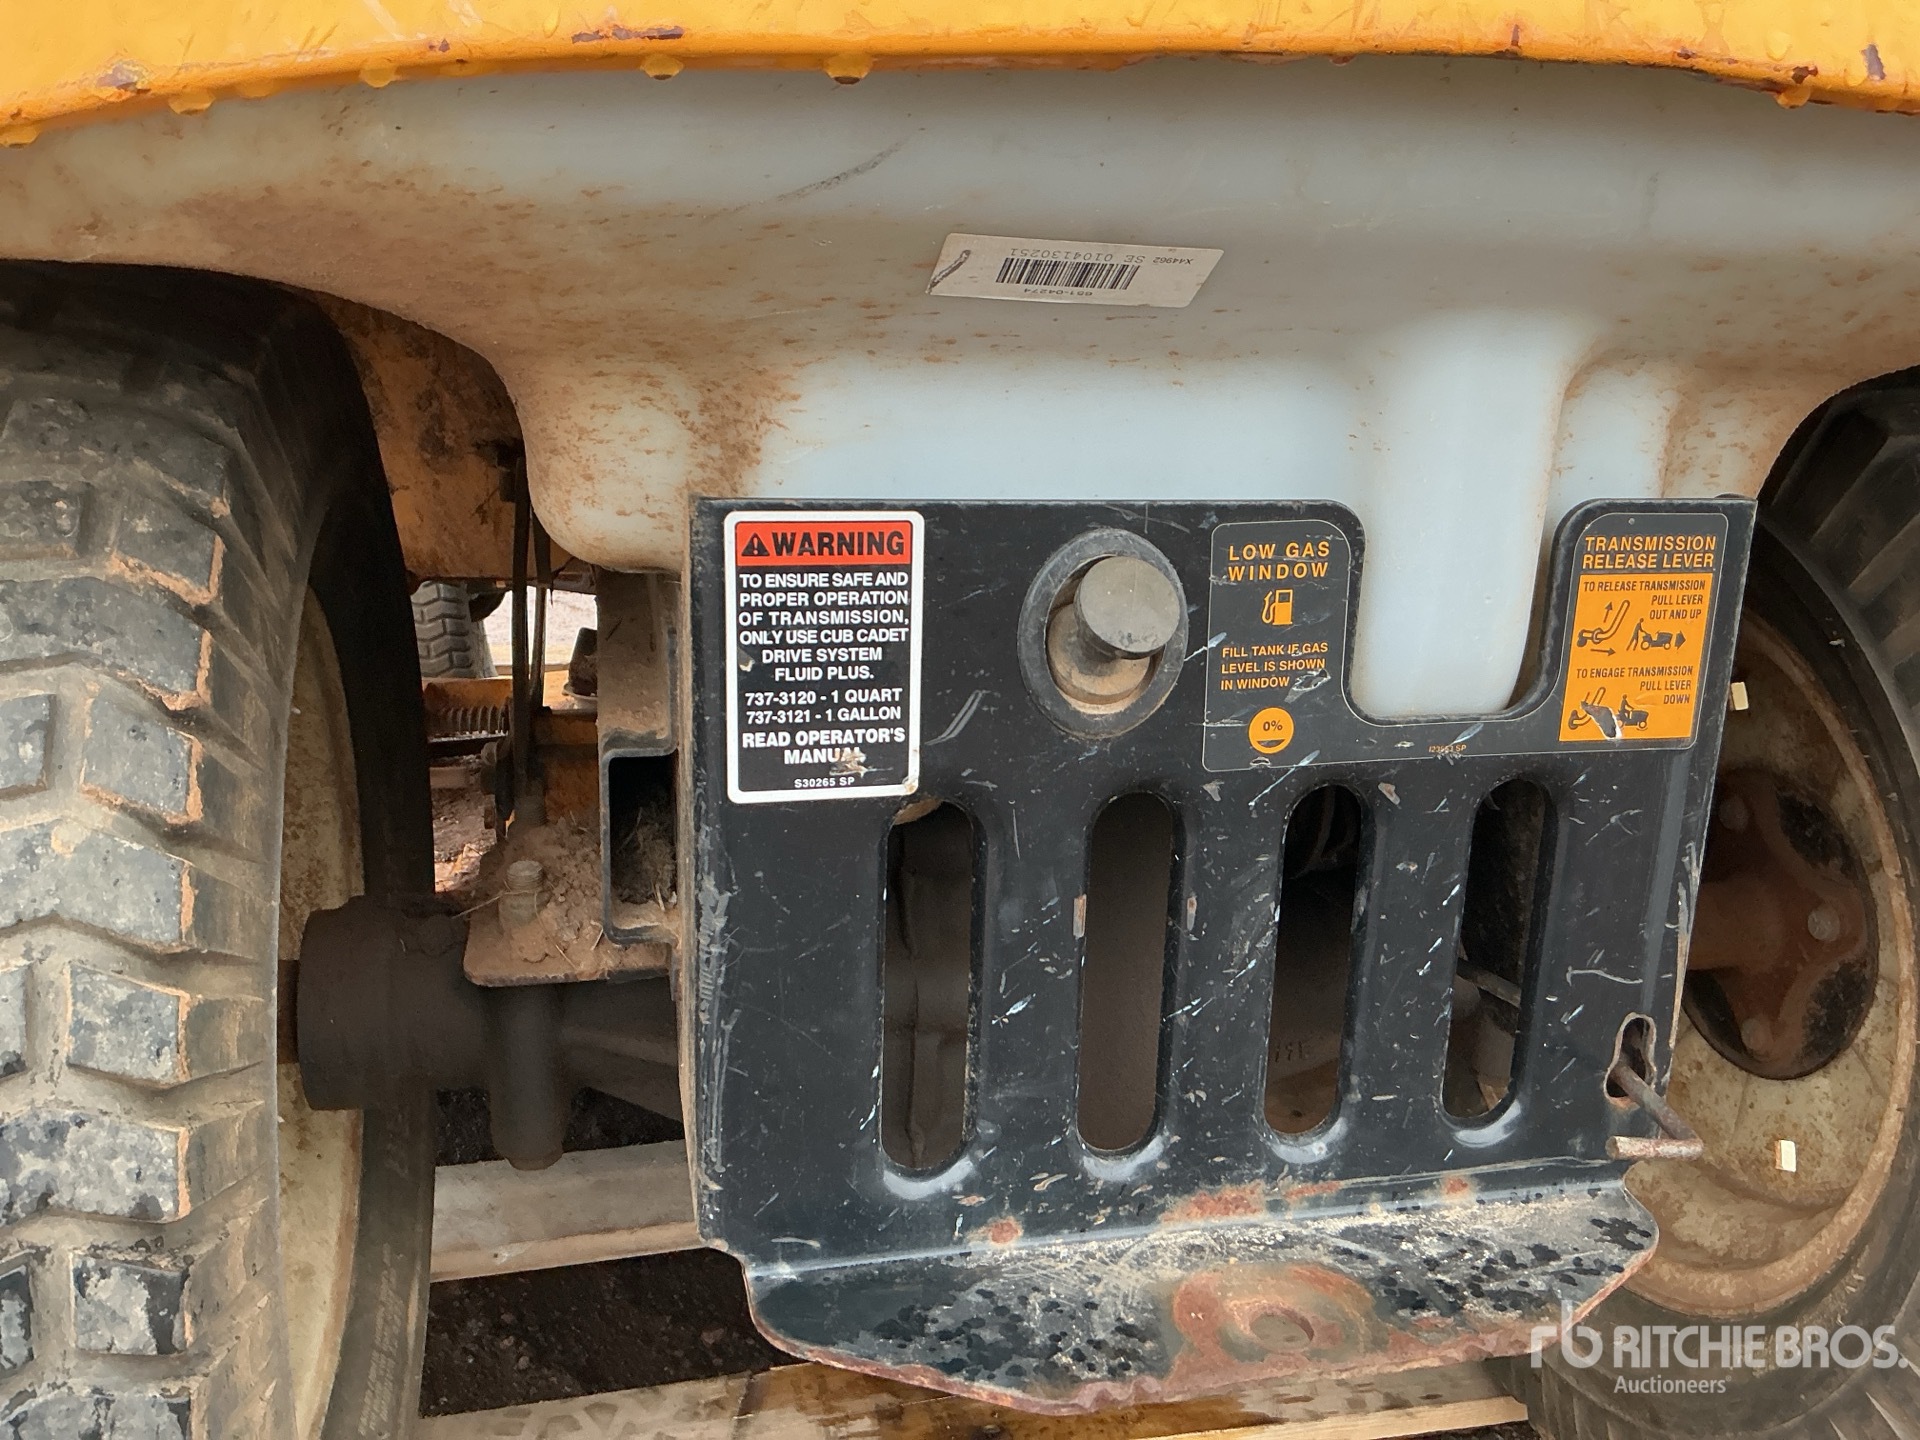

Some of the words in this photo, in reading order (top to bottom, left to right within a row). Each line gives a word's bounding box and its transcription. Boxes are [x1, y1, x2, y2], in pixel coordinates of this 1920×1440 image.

[1010, 248, 1113, 262] 0104130251
[1123, 254, 1146, 264] SE
[1152, 256, 1194, 266] X44962
[772, 531, 904, 556] WARNING
[1229, 544, 1276, 561] LOW
[1285, 541, 1330, 558] GAS
[1585, 535, 1716, 551] TRANSMISSION
[1582, 553, 1657, 569] RELEASE
[1662, 553, 1714, 568] LEVER
[739, 573, 762, 588] TO
[765, 573, 829, 588] ENSURE
[832, 572, 873, 587] SAFE
[875, 572, 908, 586] AND
[1228, 562, 1328, 582] WINDOW
[1583, 581, 1595, 592] TO
[1597, 581, 1637, 592] RELEASE
[1639, 580, 1706, 591] TRANSMISSION
[740, 592, 809, 607] PROPER
[814, 591, 908, 606] OPERATION
[1651, 595, 1674, 606] PULL
[1675, 594, 1704, 605] LEVER
[739, 612, 763, 626] OF
[769, 610, 909, 625] TRANSMISSION,
[1650, 609, 1667, 620] OUT
[1668, 609, 1688, 619] AND
[1689, 608, 1702, 619] UP
[740, 630, 783, 645] ONLY
[786, 630, 818, 644] USE
[820, 629, 854, 643] CUB
[857, 628, 909, 642] CADET
[762, 648, 812, 664] DRIVE
[816, 647, 882, 662] SYSTEM
[1222, 647, 1248, 658] FILL
[1252, 644, 1285, 656] TANK
[1288, 643, 1299, 655] IF
[1302, 642, 1328, 653] GAS
[775, 667, 823, 682] FLUID
[827, 665, 874, 680] PLUS.
[1221, 662, 1261, 674] LEVEL
[1264, 661, 1276, 672] IS
[1279, 658, 1326, 671] SHOWN
[1576, 668, 1588, 679] TO
[1590, 667, 1625, 678] ENGAGE
[1627, 665, 1694, 677] TRANSMISSION
[1220, 680, 1233, 690] IN
[1236, 676, 1290, 689] WINDOW
[1639, 680, 1662, 691] PULL
[1664, 679, 1692, 691] LEVER
[745, 691, 816, 706] 737-3120
[831, 690, 839, 703] 1
[845, 688, 903, 703] QUART
[1663, 694, 1691, 705] DOWN
[746, 709, 811, 724] 737-3121
[825, 709, 833, 722] 1
[837, 706, 901, 721] GALLON
[1262, 720, 1283, 731] 0%
[742, 732, 791, 748] READ
[795, 728, 905, 745] OPERATOR'S
[1455, 744, 1467, 752] SP
[794, 778, 836, 788] S30265
[839, 777, 855, 786] SP
